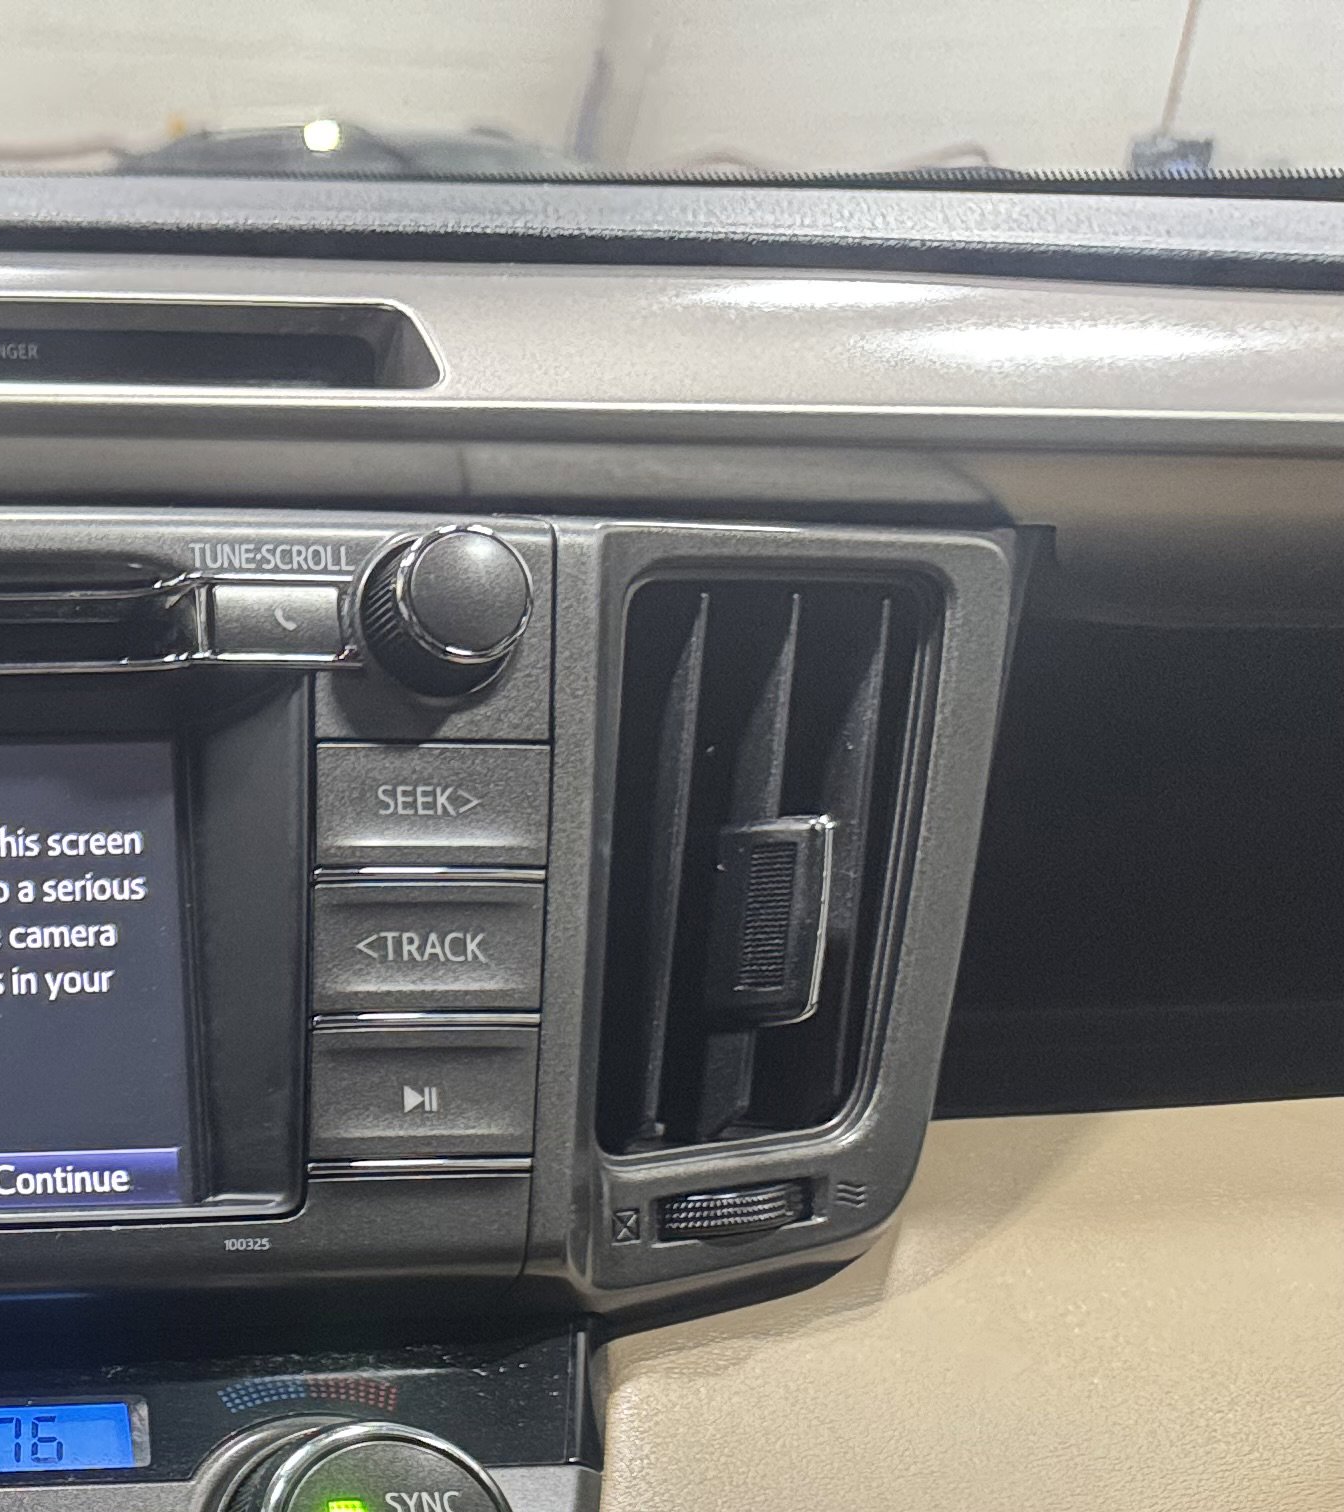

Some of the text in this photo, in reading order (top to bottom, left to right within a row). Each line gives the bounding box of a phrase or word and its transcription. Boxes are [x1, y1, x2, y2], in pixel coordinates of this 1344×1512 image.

[46, 830, 144, 857] screen
[17, 879, 36, 903] a
[42, 871, 148, 903] serious
[8, 923, 119, 949] camera
[11, 966, 38, 996] in
[44, 969, 116, 1001] your
[223, 1237, 271, 1252] 100325
